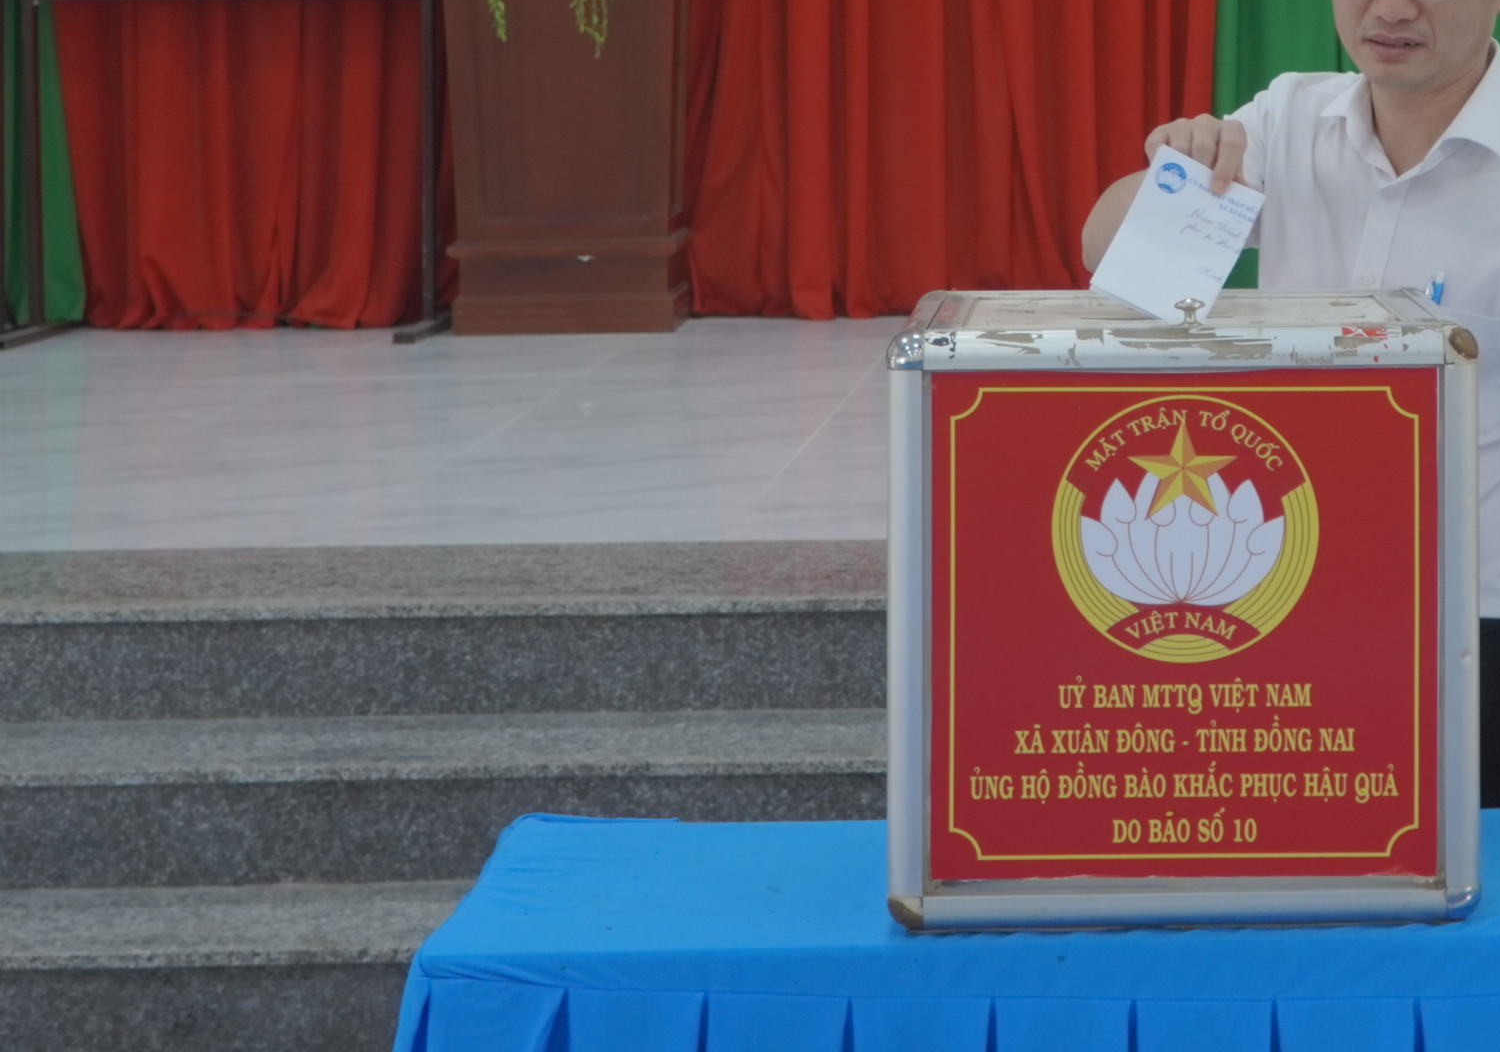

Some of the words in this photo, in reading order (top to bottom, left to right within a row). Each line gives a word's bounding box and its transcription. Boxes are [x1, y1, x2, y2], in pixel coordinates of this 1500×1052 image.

[1085, 429, 1126, 472] MẶT
[1126, 407, 1187, 436] TRẬN
[1199, 410, 1231, 431] TỔ
[1231, 423, 1283, 472] QUỐC
[1125, 610, 1179, 642] VIỆT
[1185, 612, 1237, 640] NAM
[1058, 675, 1087, 709] UỶ
[1093, 684, 1135, 708] BAN
[1142, 684, 1203, 715] MTTQ
[1209, 677, 1259, 713] VIỆT
[1266, 683, 1312, 707] NAM
[1014, 724, 1045, 754] XÃ
[1051, 722, 1110, 754] XUÂN
[1116, 722, 1176, 753] ĐÔNG
[1196, 719, 1247, 752] TỈNH
[1253, 714, 1312, 752] ĐỒNG
[1319, 728, 1355, 752] NAI
[970, 766, 1014, 800] ỦNG
[1021, 768, 1051, 805] HỘ
[1058, 761, 1118, 799] ĐỒNG
[1124, 767, 1167, 798] BÀO
[1173, 760, 1234, 798] KHẮC
[1240, 773, 1298, 803] PHỤC
[1303, 766, 1348, 803] HẬU
[1354, 763, 1399, 804] QUẢ
[1112, 818, 1142, 843] DO
[1148, 811, 1191, 843] BÃO
[1198, 807, 1226, 843] SỐ
[1234, 818, 1257, 843] 10
